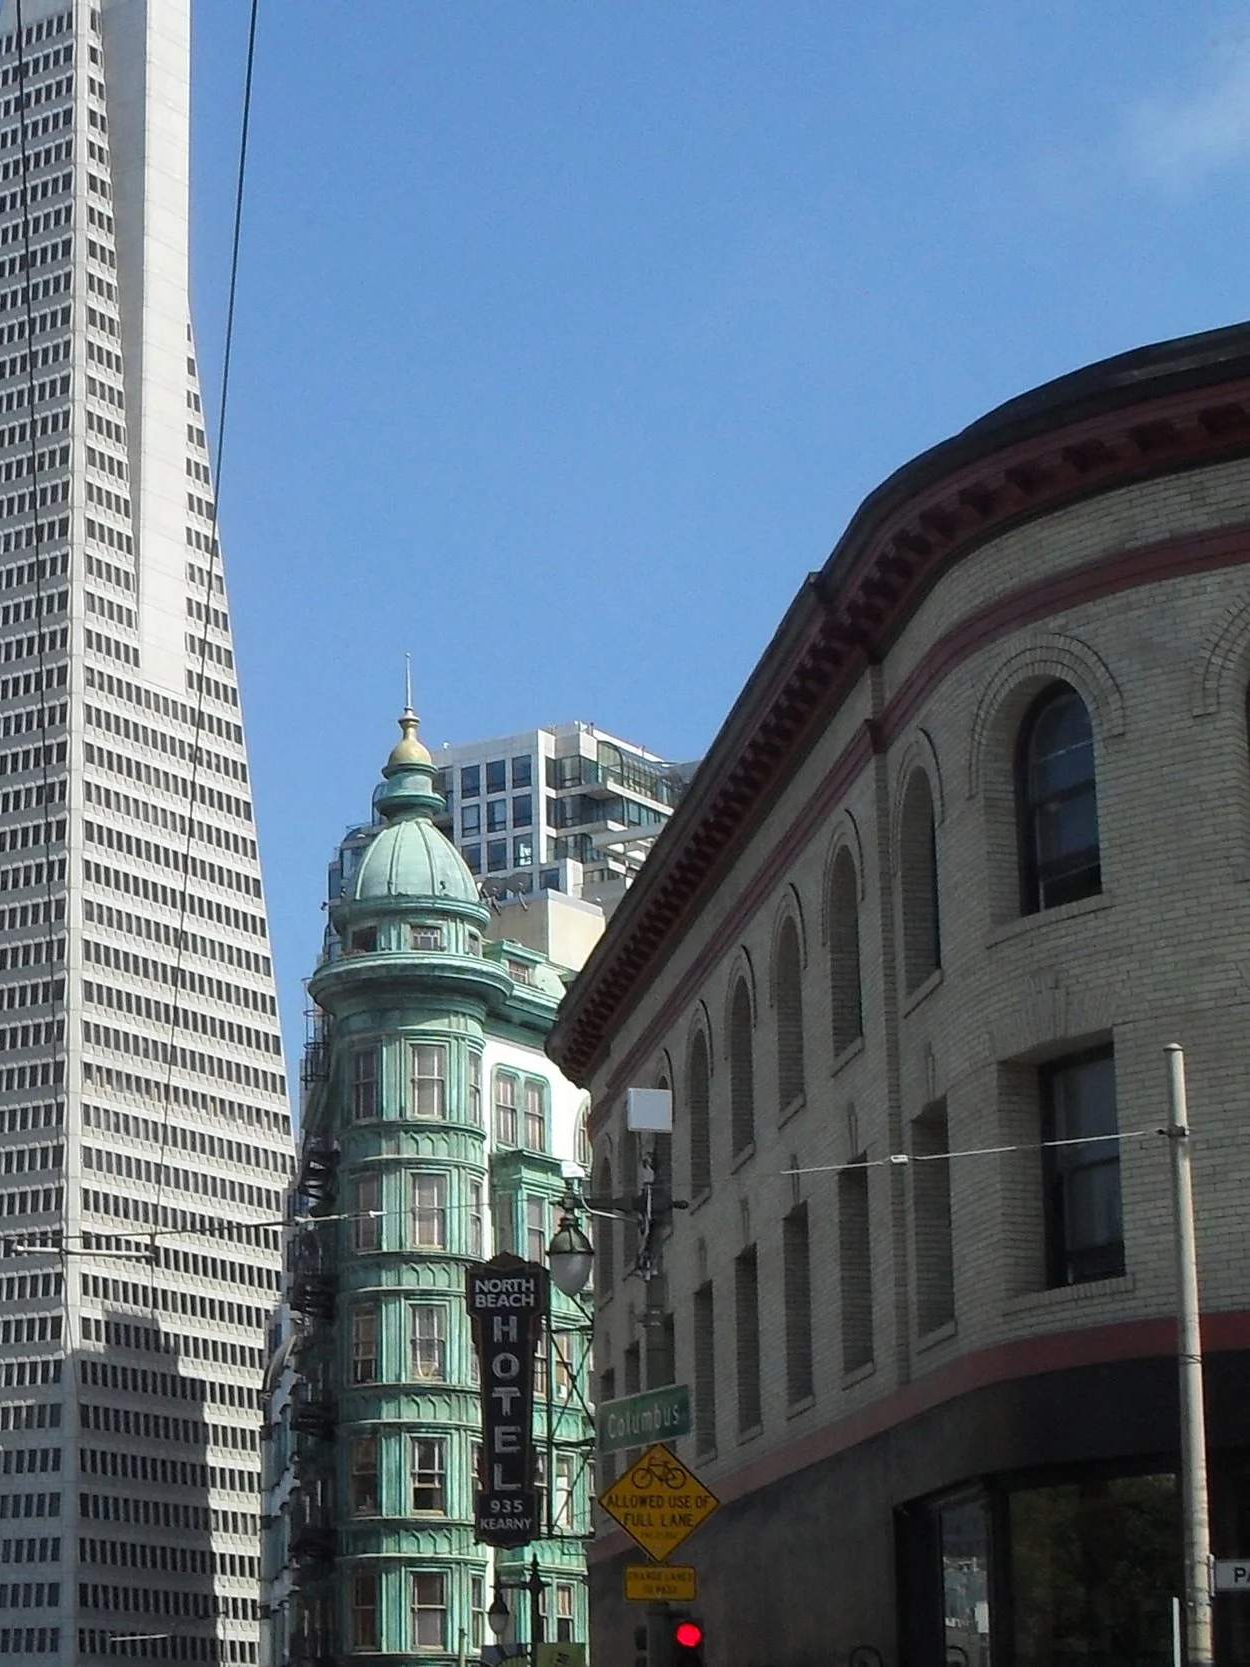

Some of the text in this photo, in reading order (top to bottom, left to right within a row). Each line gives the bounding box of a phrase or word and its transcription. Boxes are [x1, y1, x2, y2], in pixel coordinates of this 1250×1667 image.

[475, 1278, 535, 1293] NORTH
[475, 1294, 535, 1308] BEACH
[491, 1315, 521, 1491] HOTEL
[607, 1404, 680, 1439] Columbus
[490, 1500, 524, 1513] 935
[606, 1495, 711, 1509] ALLOWED USE OF
[479, 1518, 533, 1530] KEARNY
[623, 1513, 694, 1527] FULL LANE
